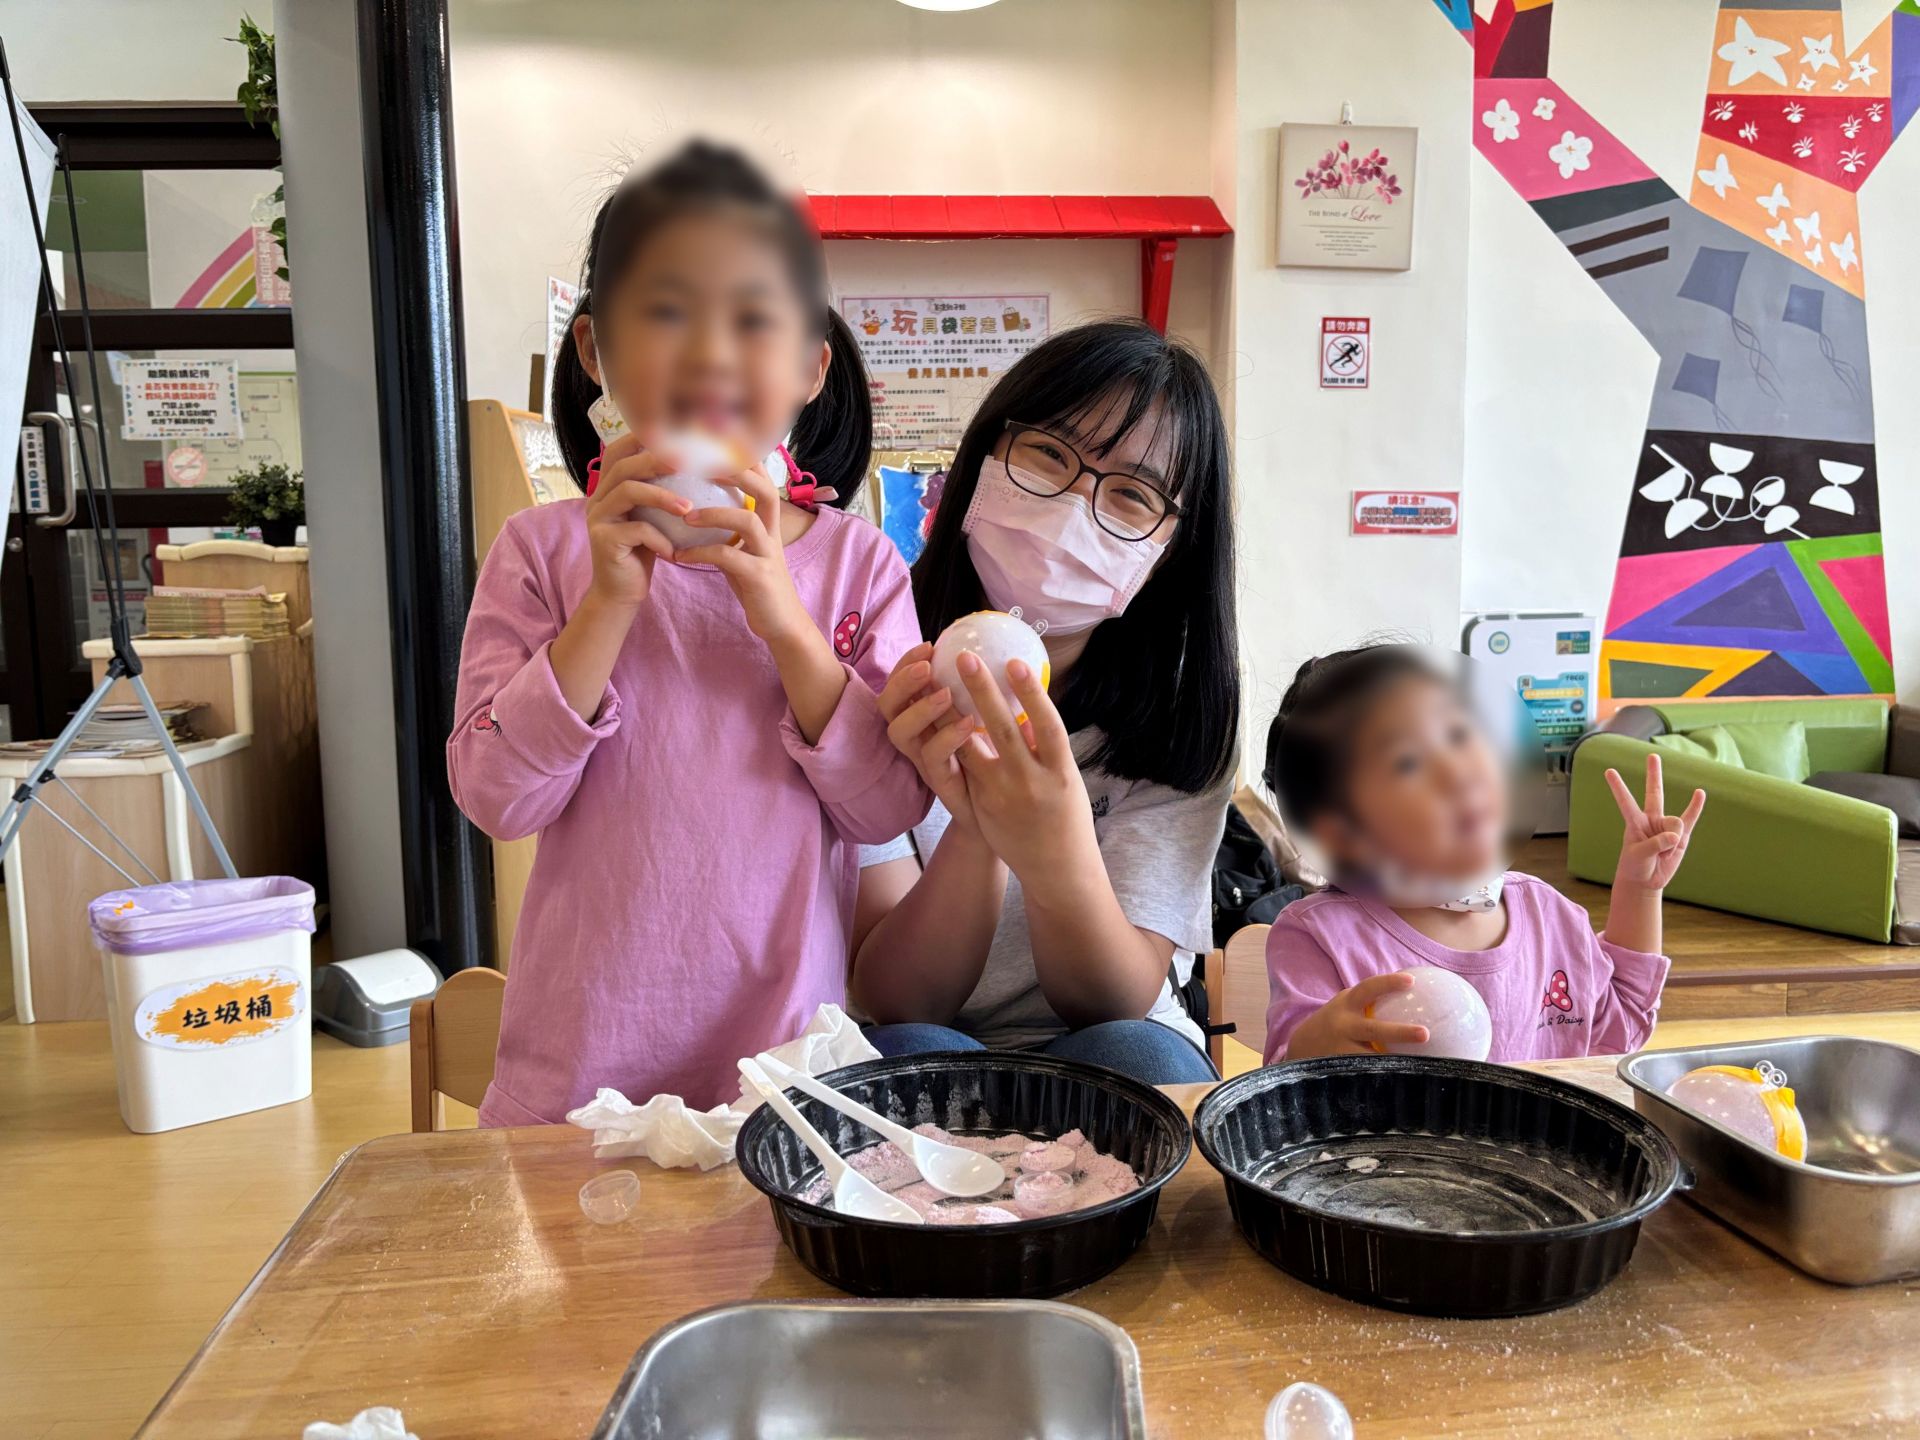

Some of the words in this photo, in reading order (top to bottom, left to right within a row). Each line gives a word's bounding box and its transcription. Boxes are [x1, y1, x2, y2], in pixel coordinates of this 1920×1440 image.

[1350, 204, 1382, 222] Love
[891, 309, 997, 336] 玩具袋著走
[1325, 320, 1367, 332] 請勿奔跑
[147, 369, 210, 379] 離開前請記得
[182, 994, 272, 1029] 垃圾桶
[1556, 1014, 1585, 1026] Daisy
